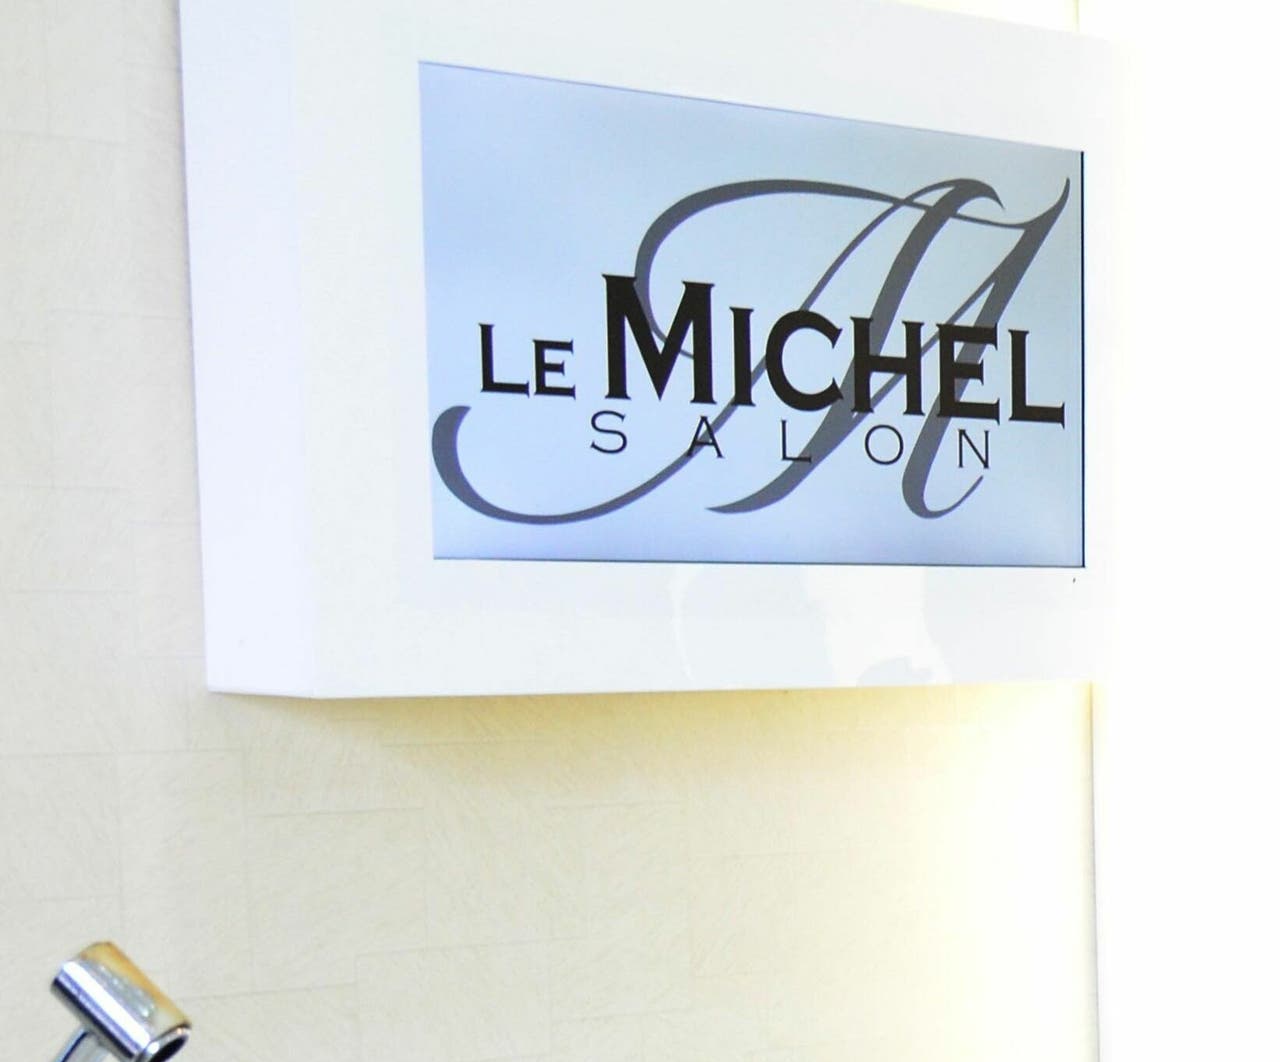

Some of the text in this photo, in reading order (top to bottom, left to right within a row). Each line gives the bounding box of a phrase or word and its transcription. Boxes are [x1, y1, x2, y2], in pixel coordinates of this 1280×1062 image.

[479, 272, 1066, 428] LE MICHEL
[590, 409, 990, 470] SALON
